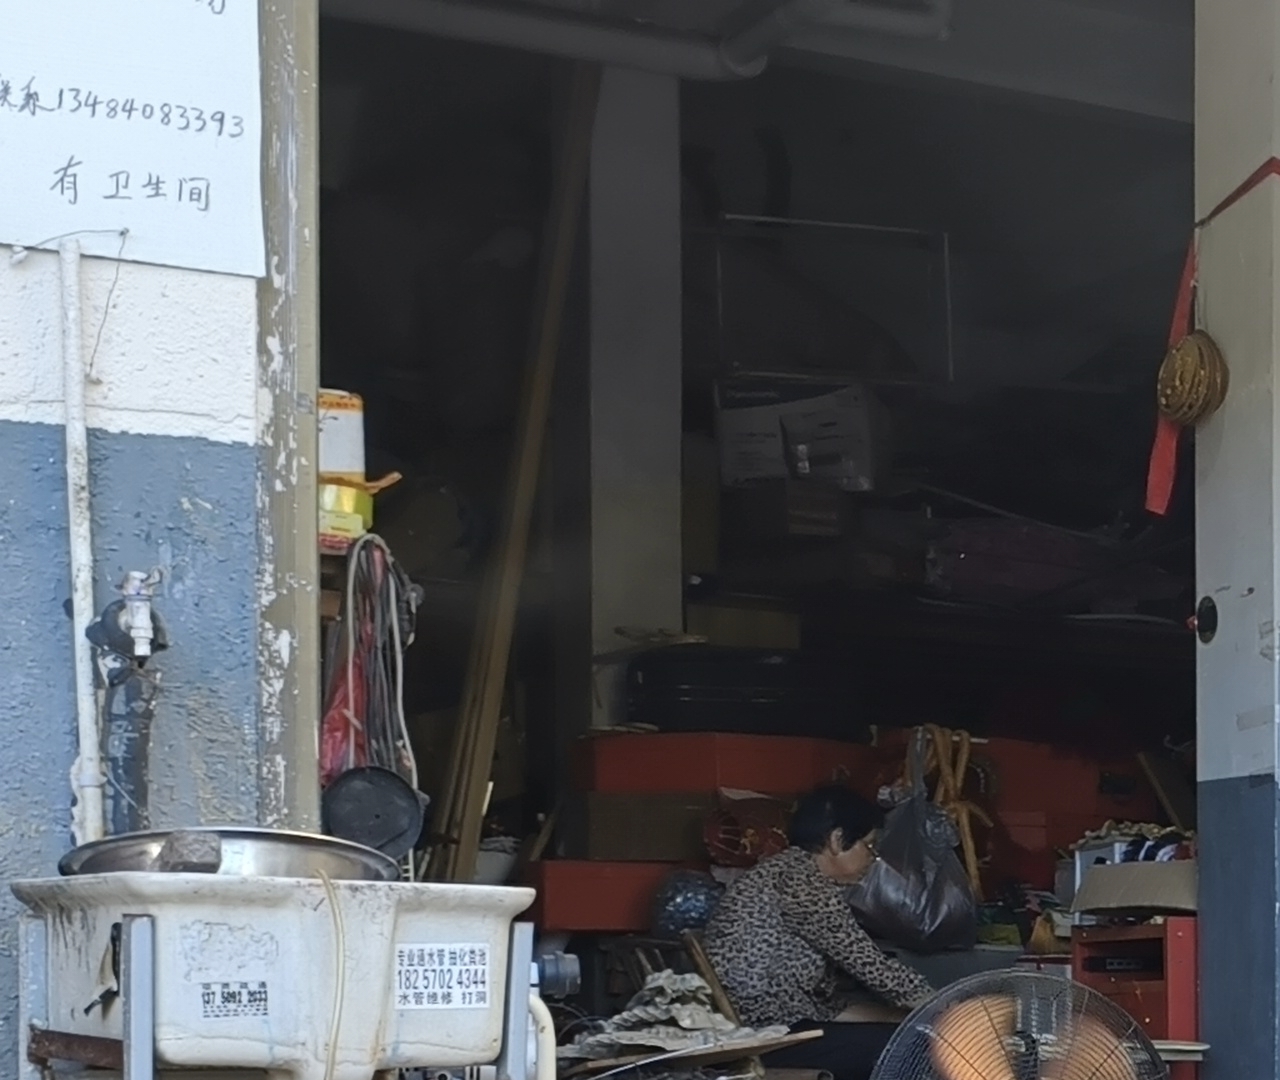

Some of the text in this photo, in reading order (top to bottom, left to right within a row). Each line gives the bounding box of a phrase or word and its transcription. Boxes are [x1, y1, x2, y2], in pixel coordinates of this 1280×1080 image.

[397, 968, 486, 990] 182 5702 4344
[461, 991, 487, 1005] 打洞
